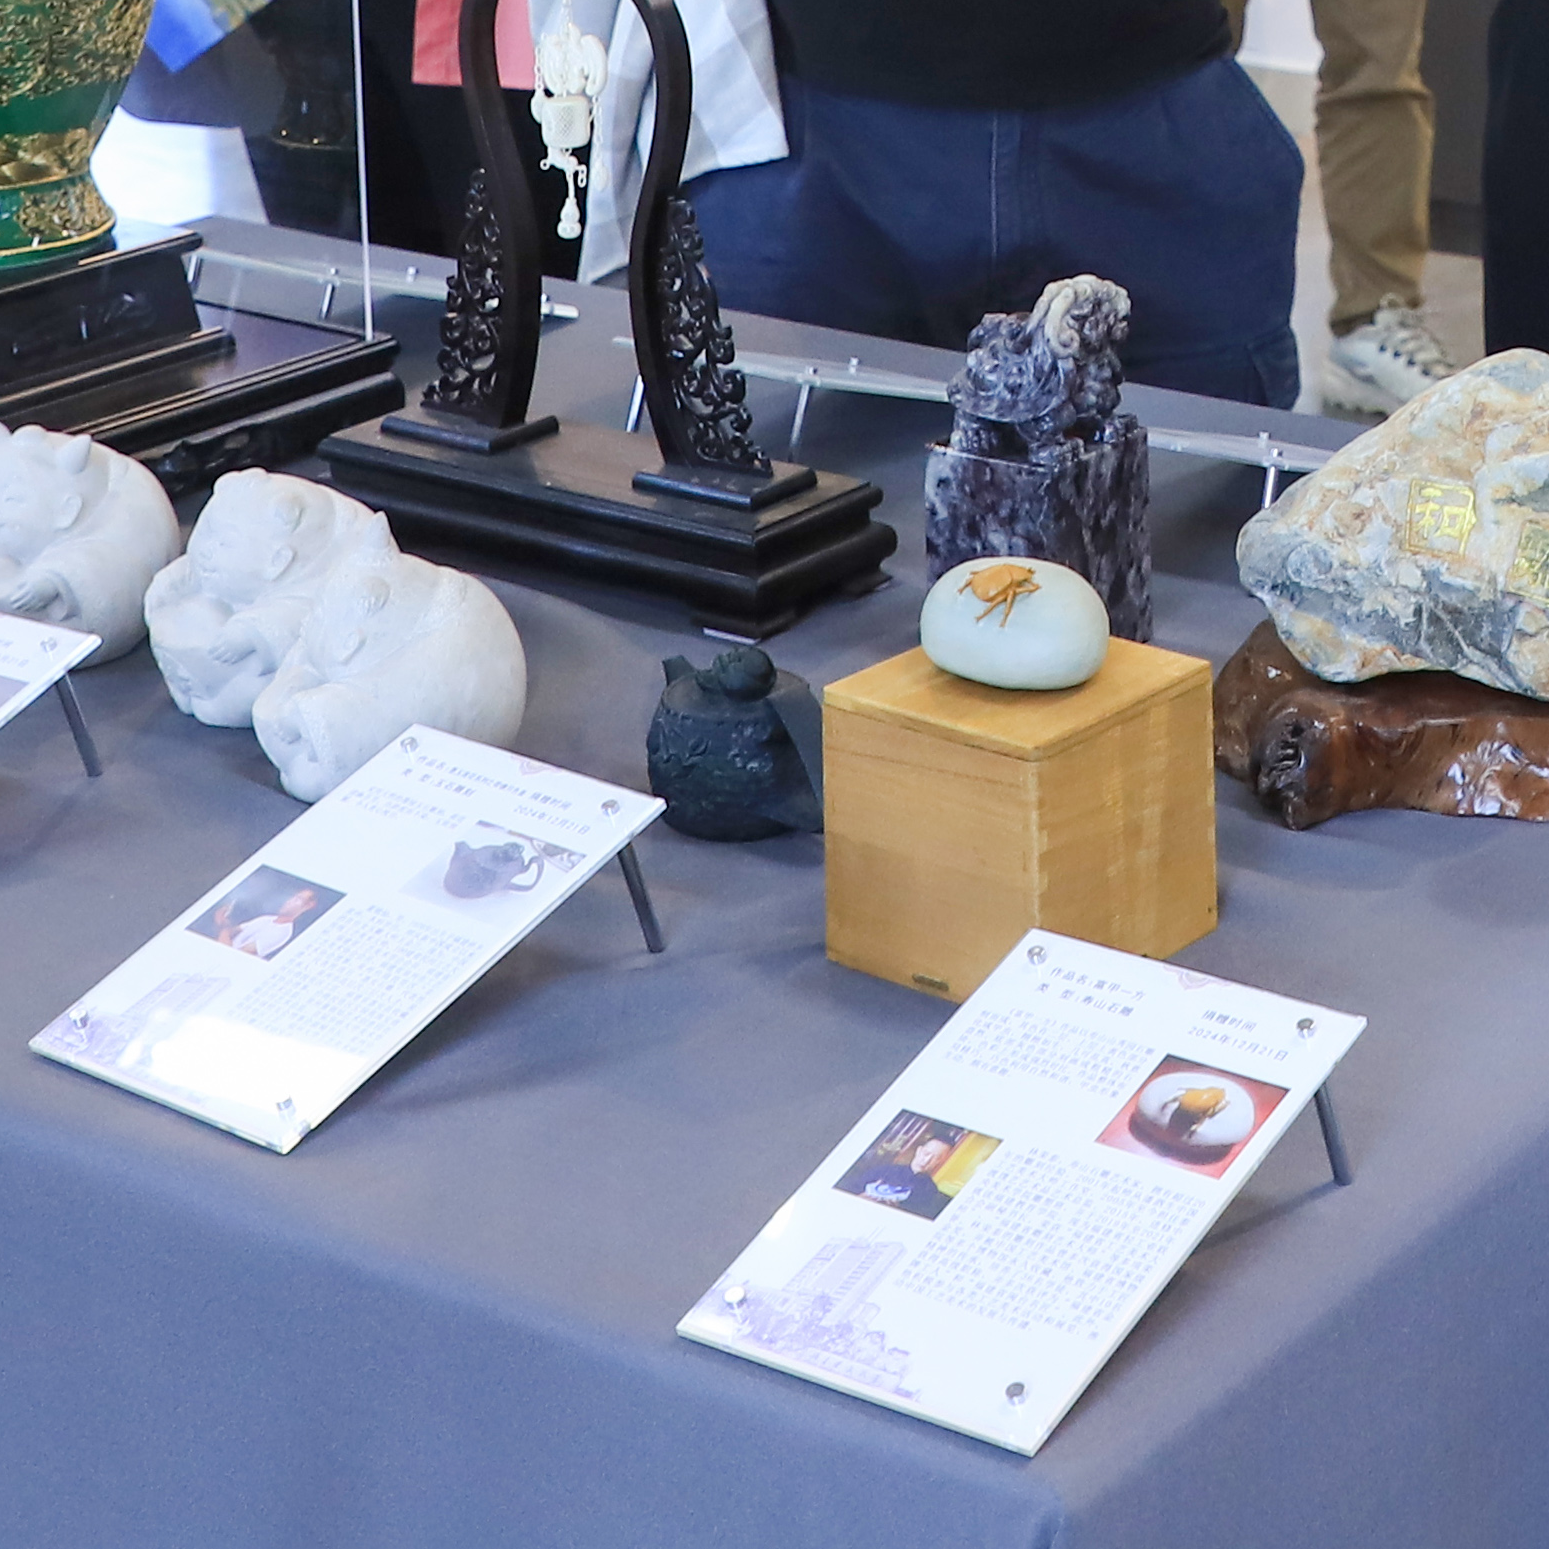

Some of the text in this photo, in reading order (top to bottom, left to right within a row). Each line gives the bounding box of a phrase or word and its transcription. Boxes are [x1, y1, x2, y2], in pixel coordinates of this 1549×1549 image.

[1415, 487, 1468, 539] 和
[1199, 1008, 1259, 1032] 捐赠时间
[1184, 1025, 1290, 1062] 2024年12月21日
